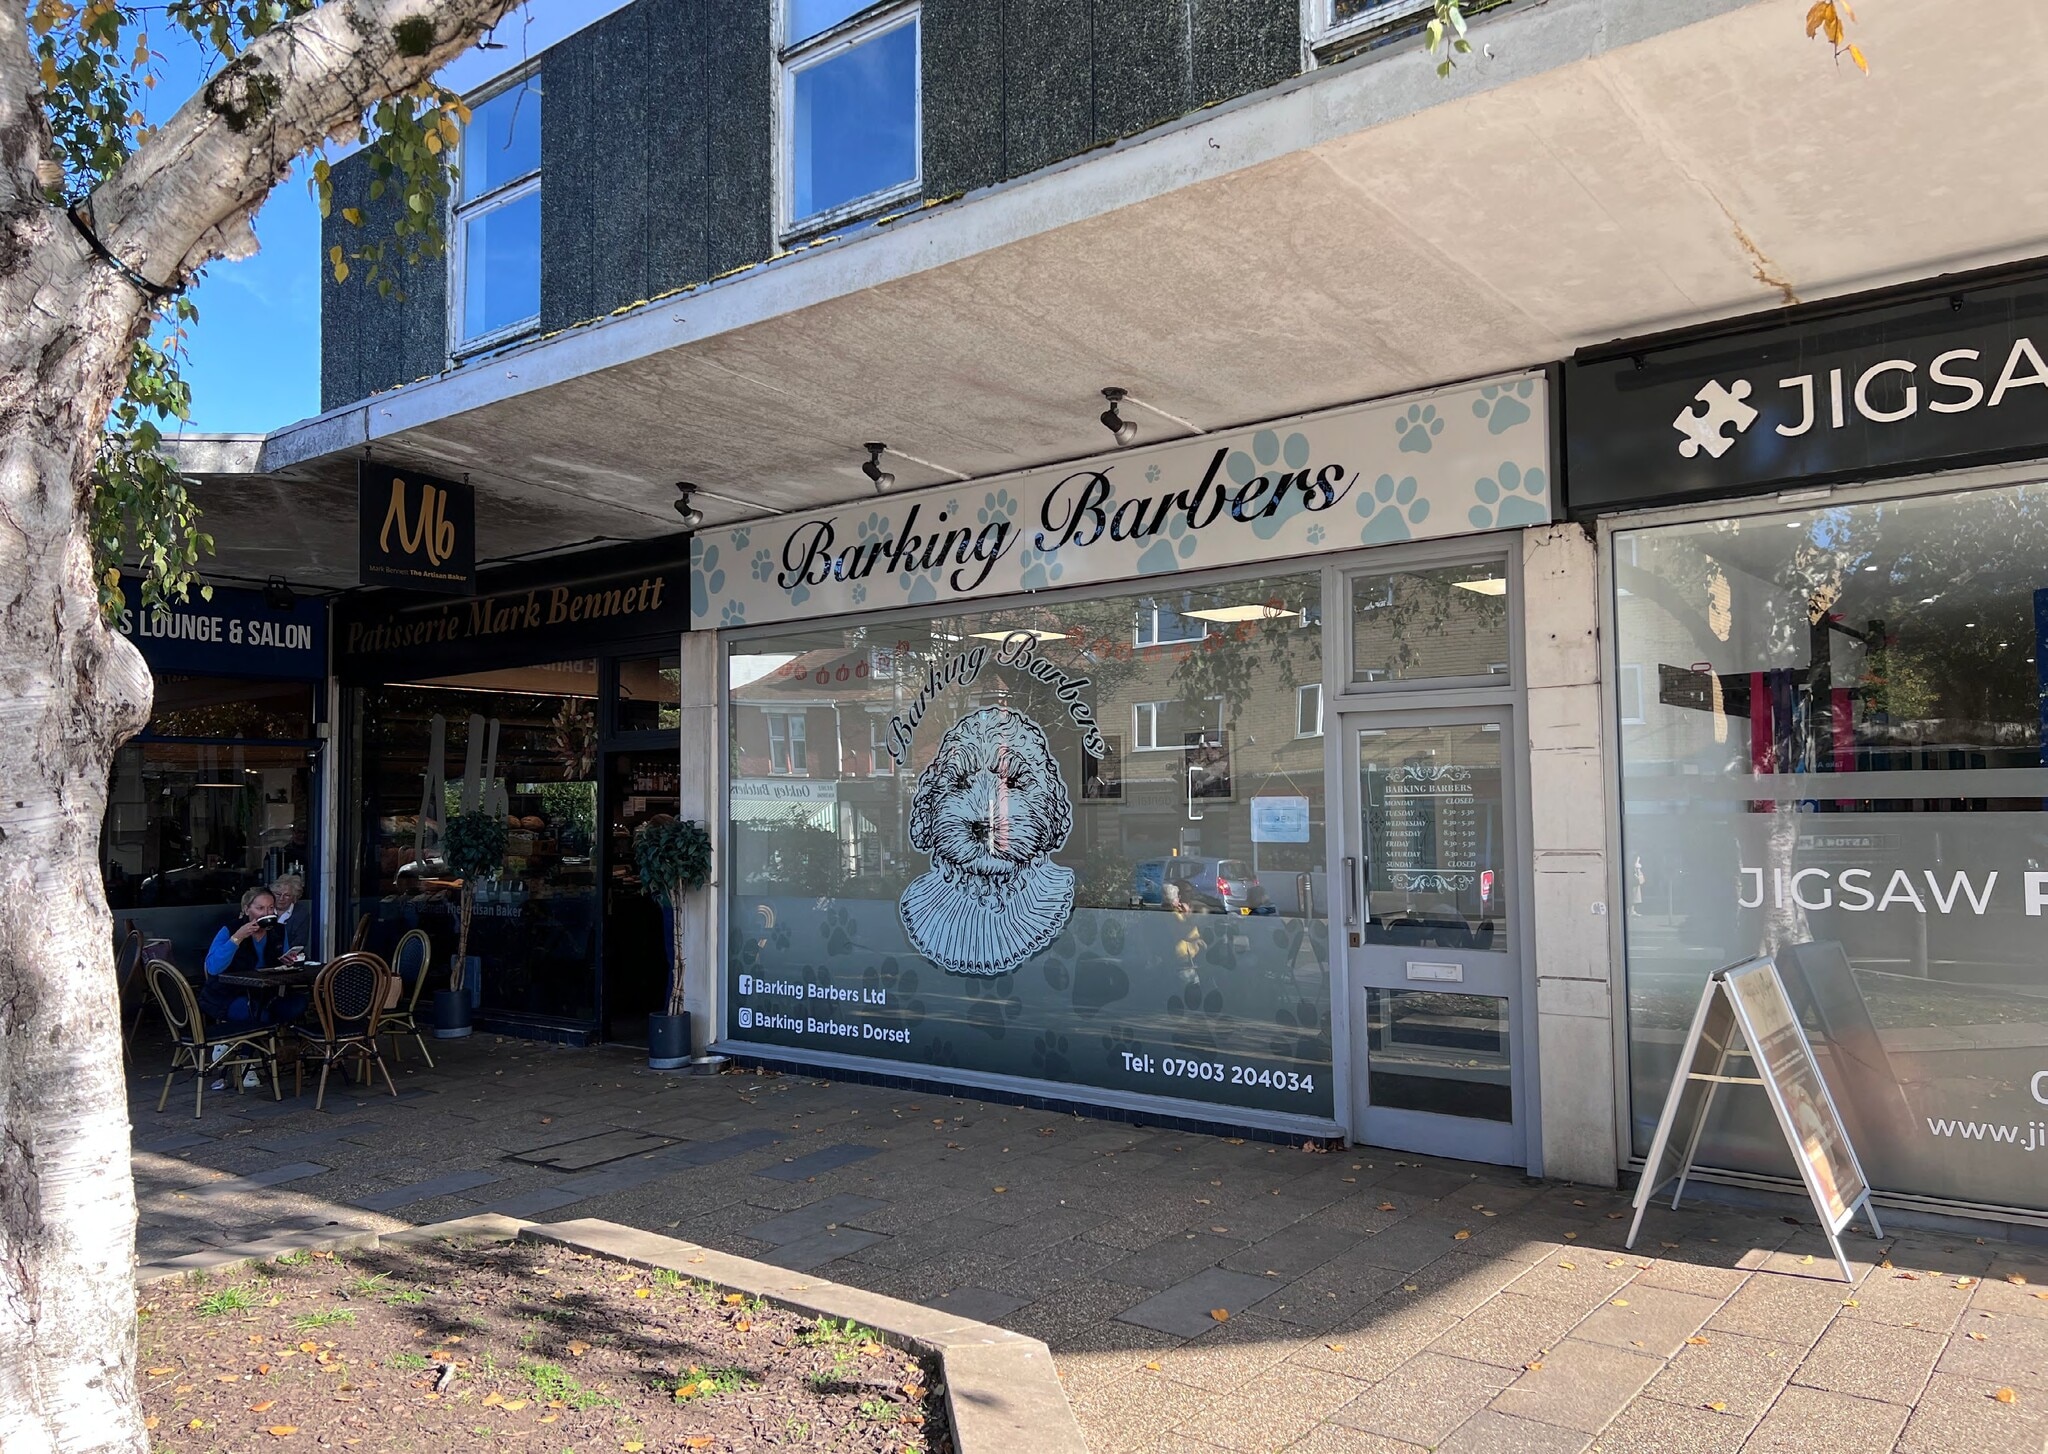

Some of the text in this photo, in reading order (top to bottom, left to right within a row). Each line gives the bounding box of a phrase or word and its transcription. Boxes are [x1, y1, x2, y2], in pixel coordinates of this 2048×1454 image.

[380, 478, 455, 567] Mb
[778, 447, 1360, 592] Barking Barbers
[369, 564, 385, 573] Mark
[410, 569, 422, 577] The
[423, 570, 446, 579] Artisan
[448, 573, 467, 581] Baker
[140, 610, 223, 643] LOUNGE
[229, 619, 243, 644] &
[248, 620, 311, 650] SALON
[347, 576, 665, 653] Patisserie Mark Bennett
[885, 630, 1104, 766] Barking Barbers
[1384, 797, 1474, 807] MONDAY CLOSED
[1385, 783, 1473, 794] BARKING BARBERS
[1386, 860, 1477, 869] SUNDAY CLOSED
[1738, 867, 1998, 915] JIGSAW
[447, 904, 461, 915] The
[469, 904, 494, 916] rtisan
[496, 904, 522, 917] Baker
[755, 979, 886, 1005] Barking Barbers Ltd
[755, 1012, 911, 1044] Barking Barbers Dorset
[1121, 1052, 1315, 1094] Tel: 07903 204034
